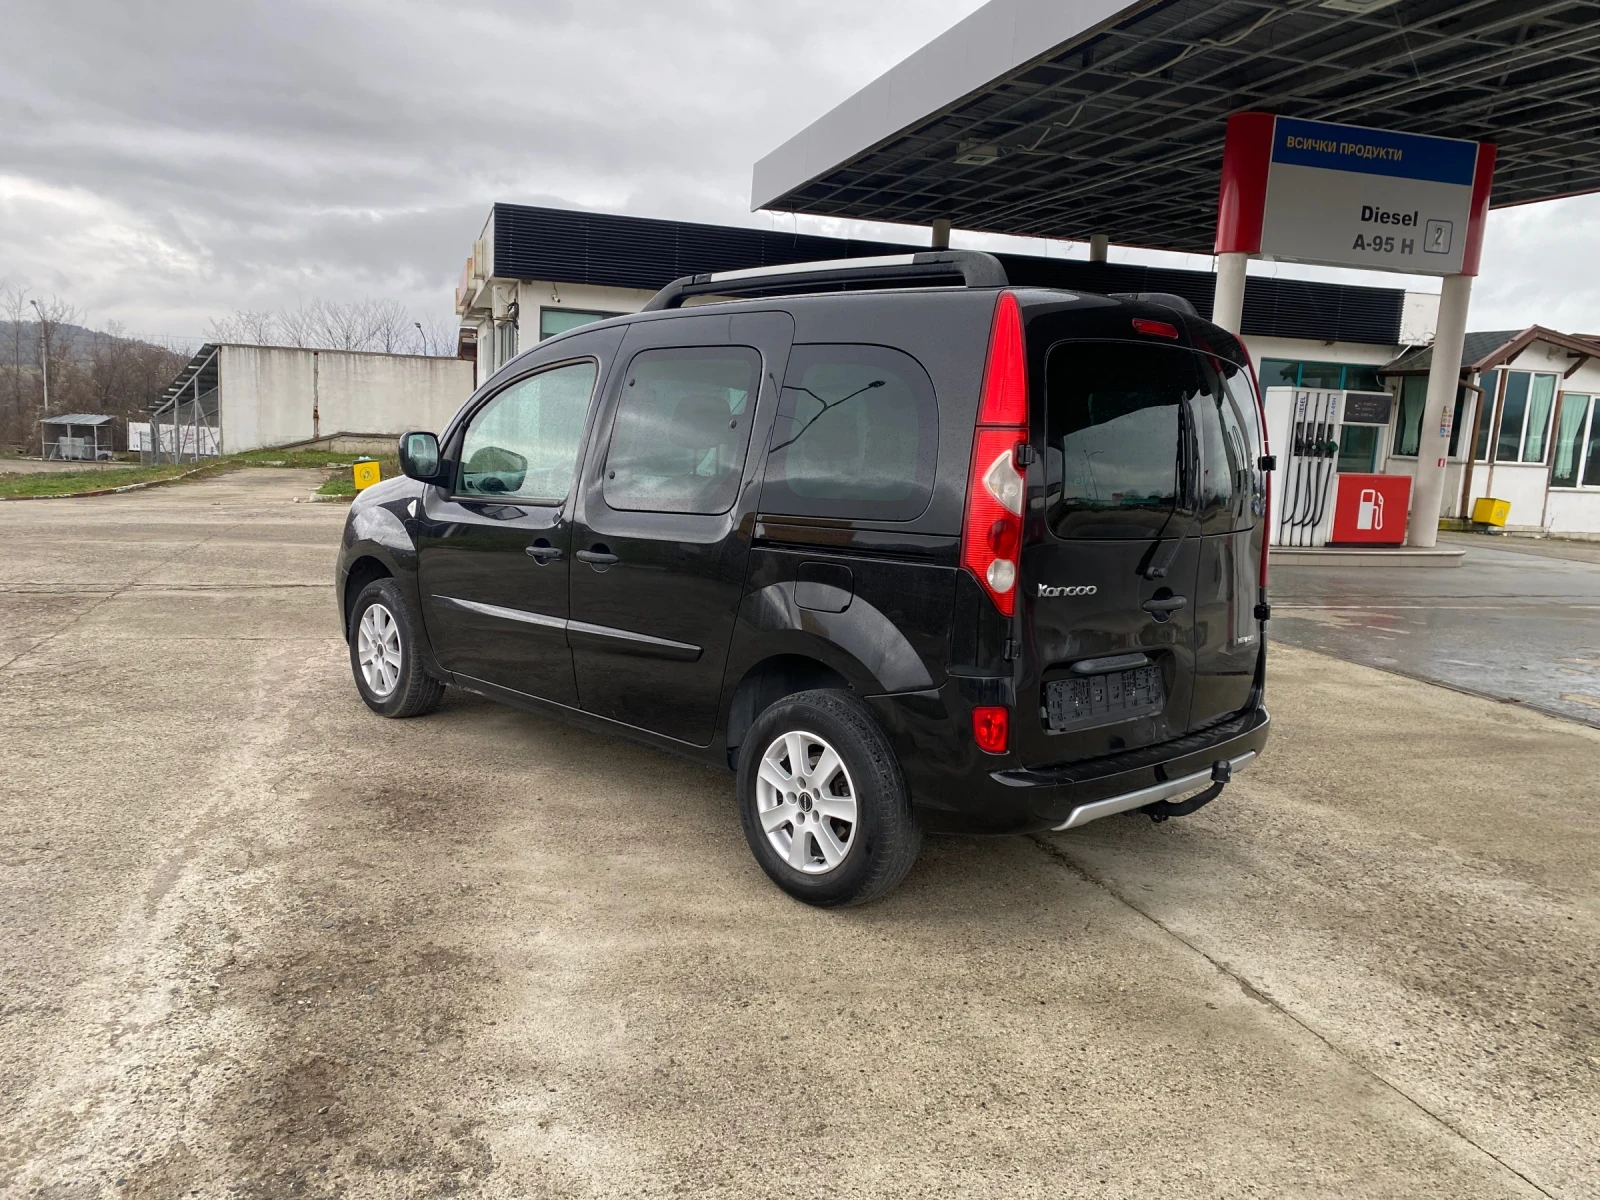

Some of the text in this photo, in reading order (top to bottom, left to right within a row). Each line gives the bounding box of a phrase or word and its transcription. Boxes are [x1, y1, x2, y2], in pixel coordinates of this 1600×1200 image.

[1286, 136, 1403, 161] ВСИЧКИ ПРОДУКТИ
[1360, 205, 1419, 227] Diesel
[1352, 233, 1415, 255] A-95 H
[1434, 227, 1443, 245] 2
[1037, 583, 1098, 598] Kangoo
